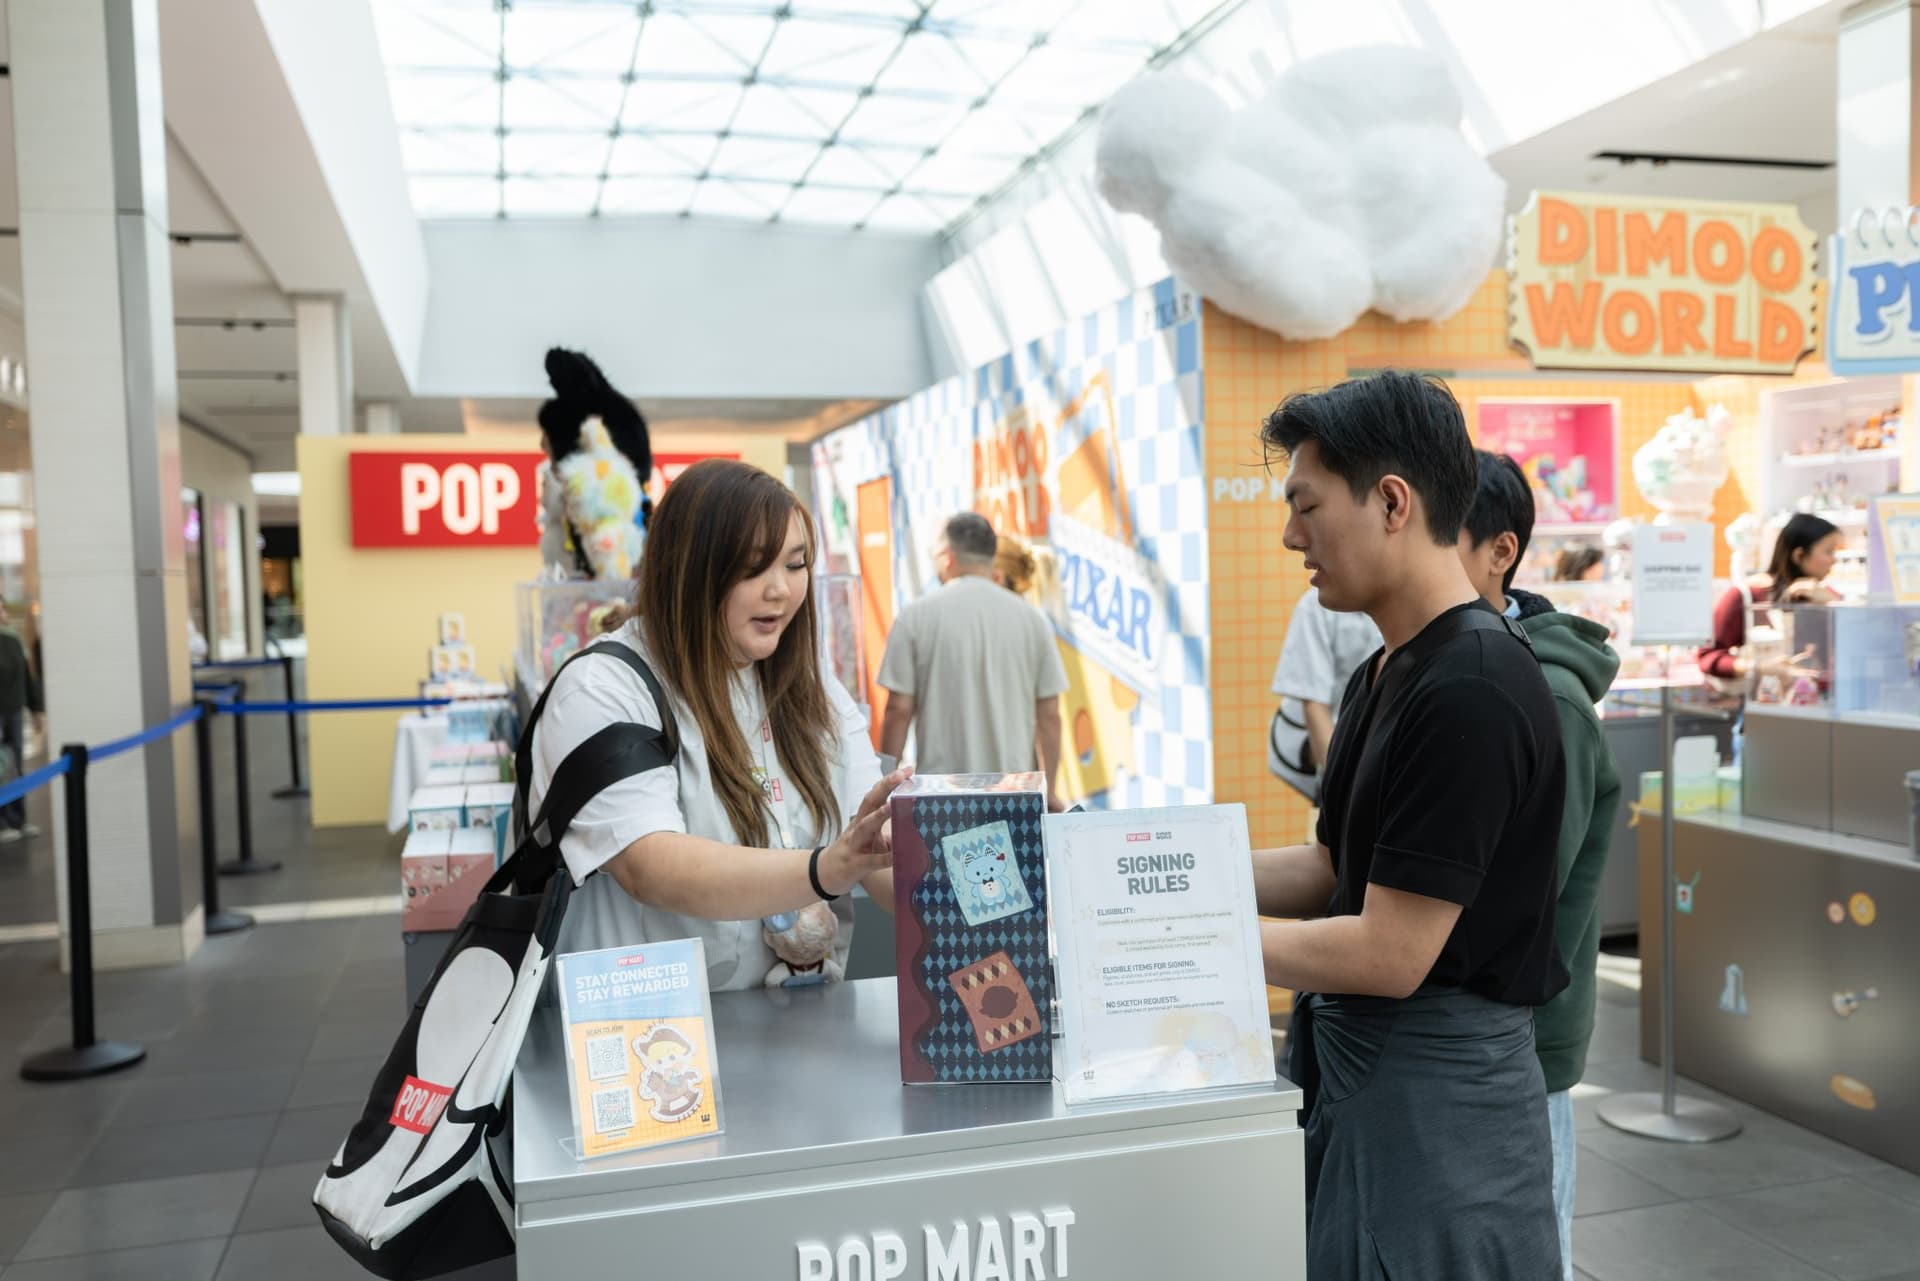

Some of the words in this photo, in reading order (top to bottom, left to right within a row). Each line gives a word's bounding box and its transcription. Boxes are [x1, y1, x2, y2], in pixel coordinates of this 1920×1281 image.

[1538, 197, 1803, 293] DIMOO
[1524, 279, 1805, 364] WORLD
[401, 462, 521, 536] POP
[1213, 476, 1265, 503] POP
[1117, 852, 1195, 875] SIGNING
[1127, 874, 1190, 896] RULES
[576, 973, 608, 990] STAY
[610, 962, 688, 985] CONNECTED
[577, 987, 610, 1003] STAY
[612, 976, 689, 999] REWARDED
[395, 1084, 429, 1123] POP
[797, 1231, 907, 1281] POP
[923, 1205, 1076, 1281] MART
